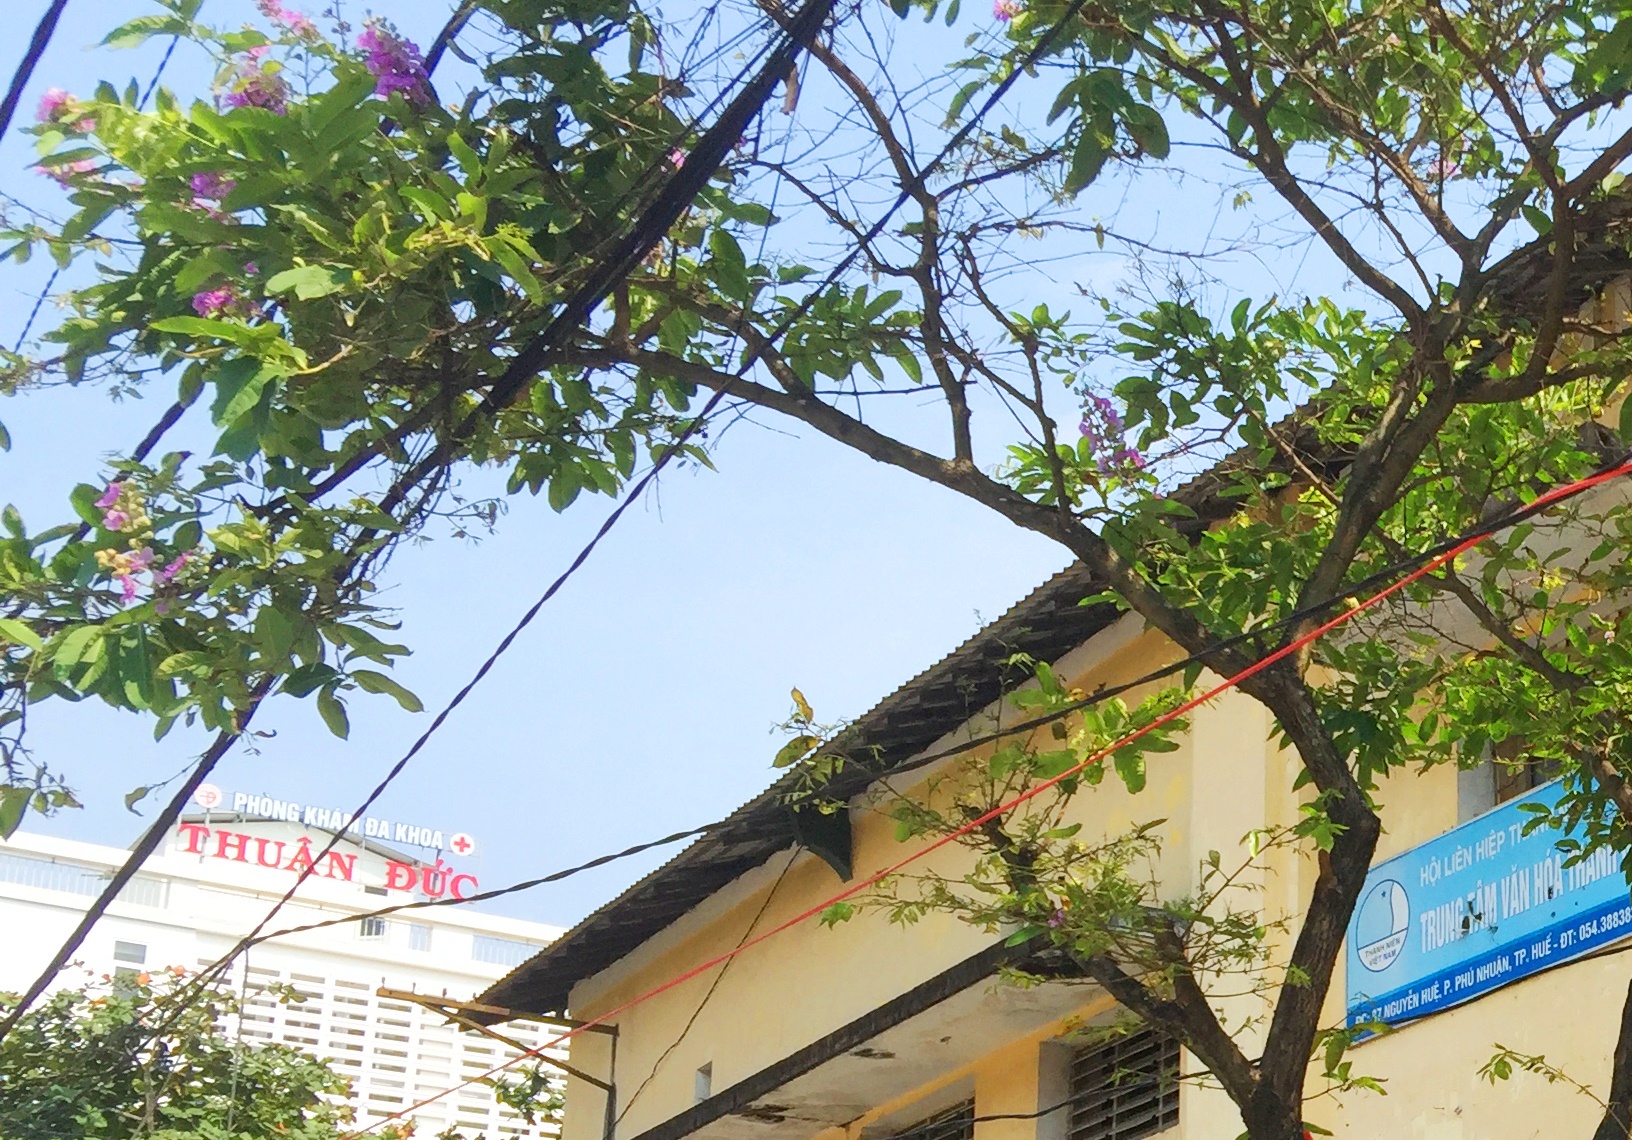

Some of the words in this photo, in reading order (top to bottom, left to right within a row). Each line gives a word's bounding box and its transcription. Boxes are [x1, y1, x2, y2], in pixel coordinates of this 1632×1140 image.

[234, 791, 300, 822] PHÒNG
[304, 805, 360, 834] KHÁM
[365, 816, 390, 840] ĐA
[395, 822, 444, 849] KHOA
[384, 858, 479, 903] ĐỨC
[1420, 855, 1442, 888] HỘI
[1444, 844, 1473, 878] LIÊN
[1475, 828, 1506, 862] HIỆP
[1501, 863, 1530, 920] VĂN
[1534, 847, 1563, 907] HÓA
[1443, 980, 1453, 997] P.
[1454, 967, 1475, 992] PHÚ
[1476, 953, 1513, 984] NHUẬN,
[1513, 947, 1530, 966] TP.
[1531, 931, 1552, 961] HUẾ
[1560, 929, 1577, 950] ĐT:
